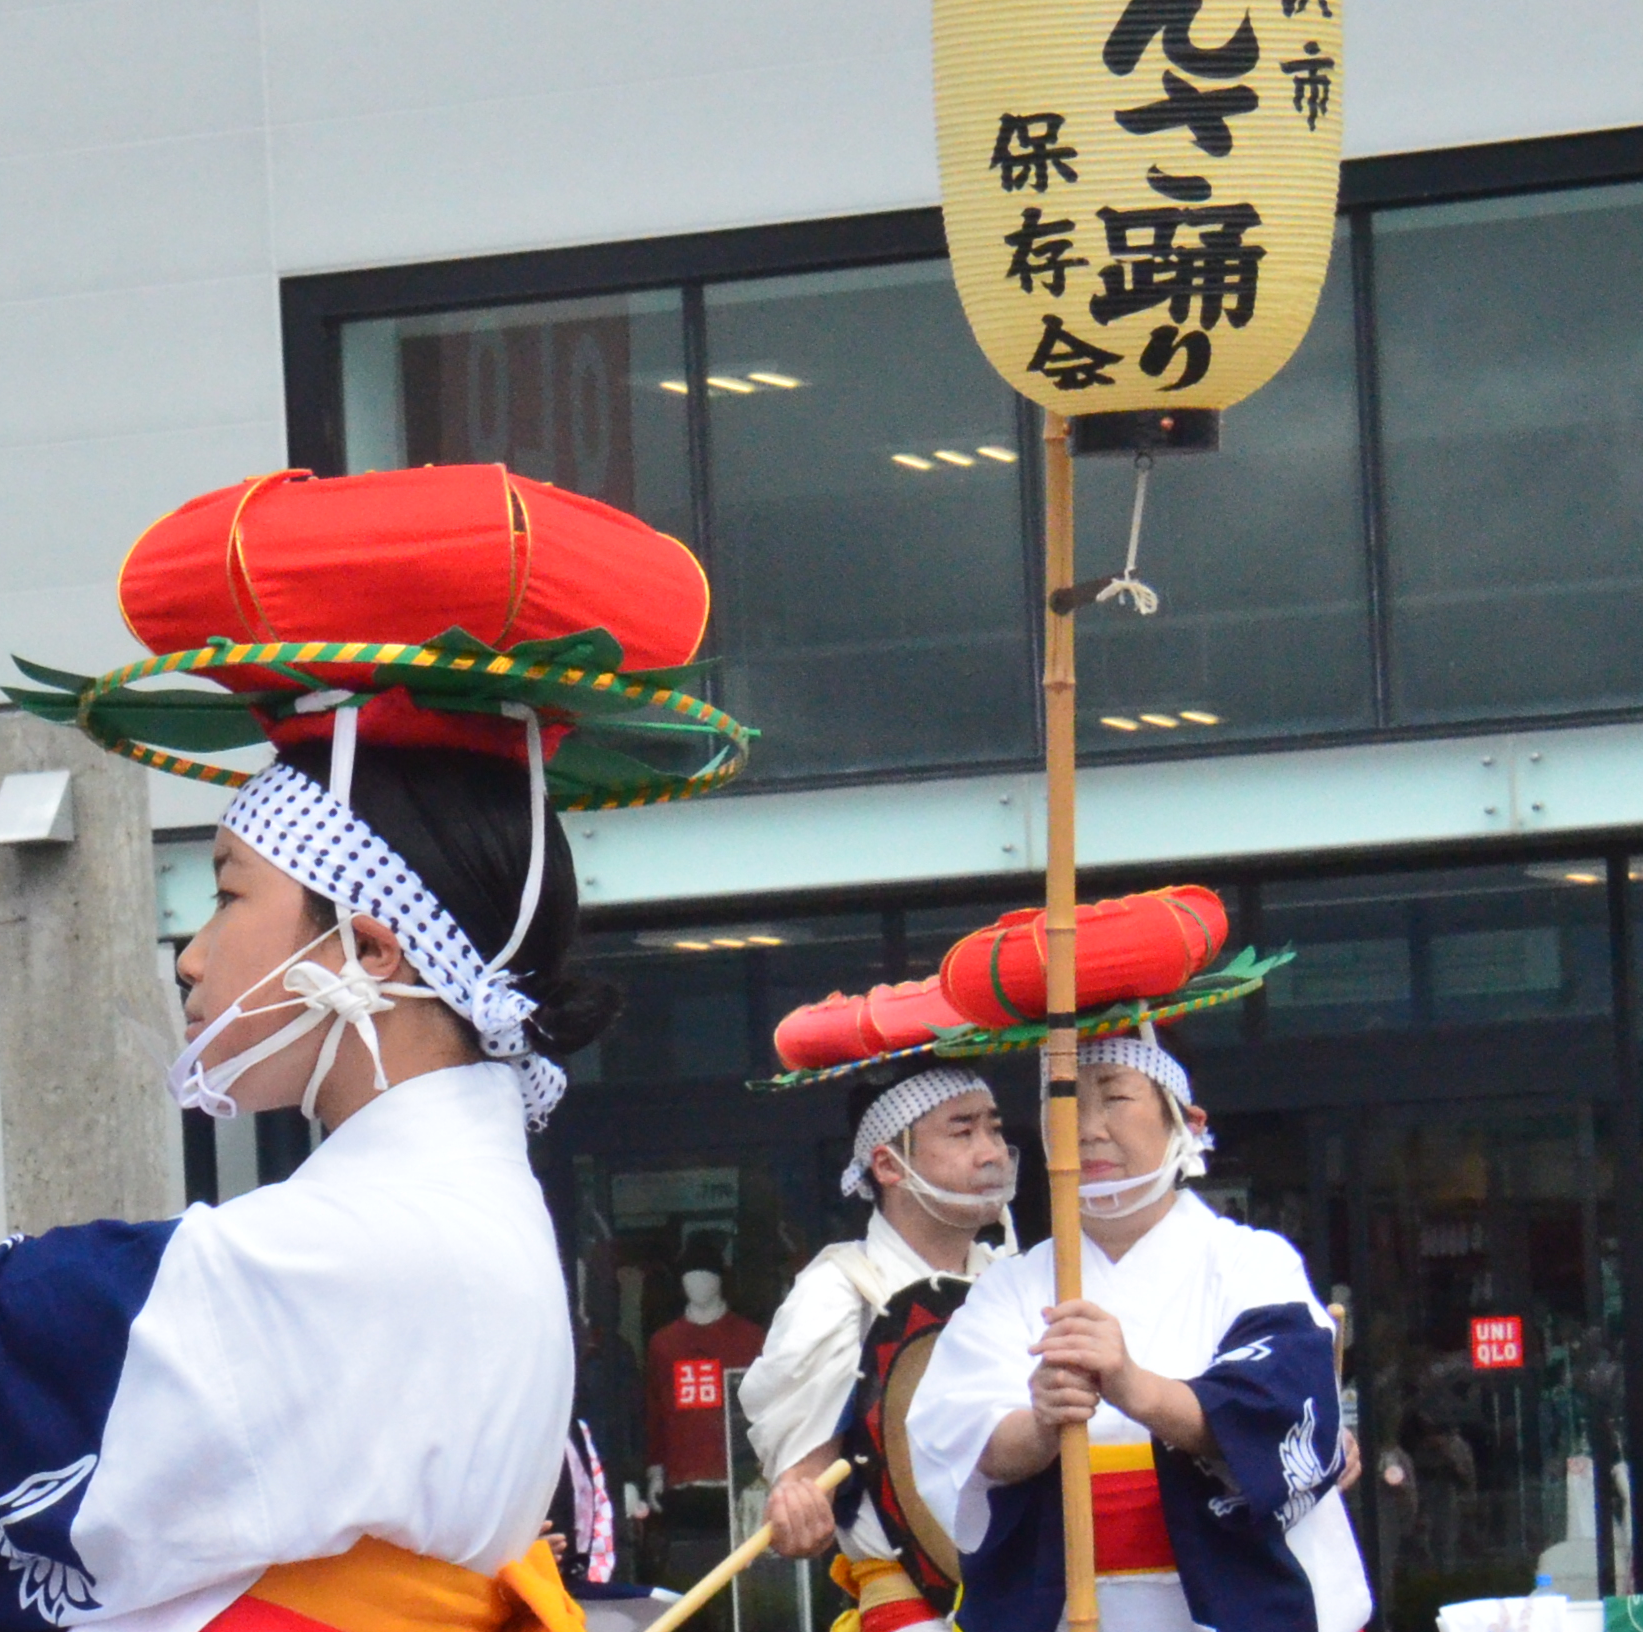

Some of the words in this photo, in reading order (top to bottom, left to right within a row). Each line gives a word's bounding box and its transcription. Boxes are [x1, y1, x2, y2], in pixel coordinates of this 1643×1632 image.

[989, 112, 1124, 391] 保存会
[1476, 1321, 1514, 1341] UNI
[1477, 1341, 1518, 1366] QLO
